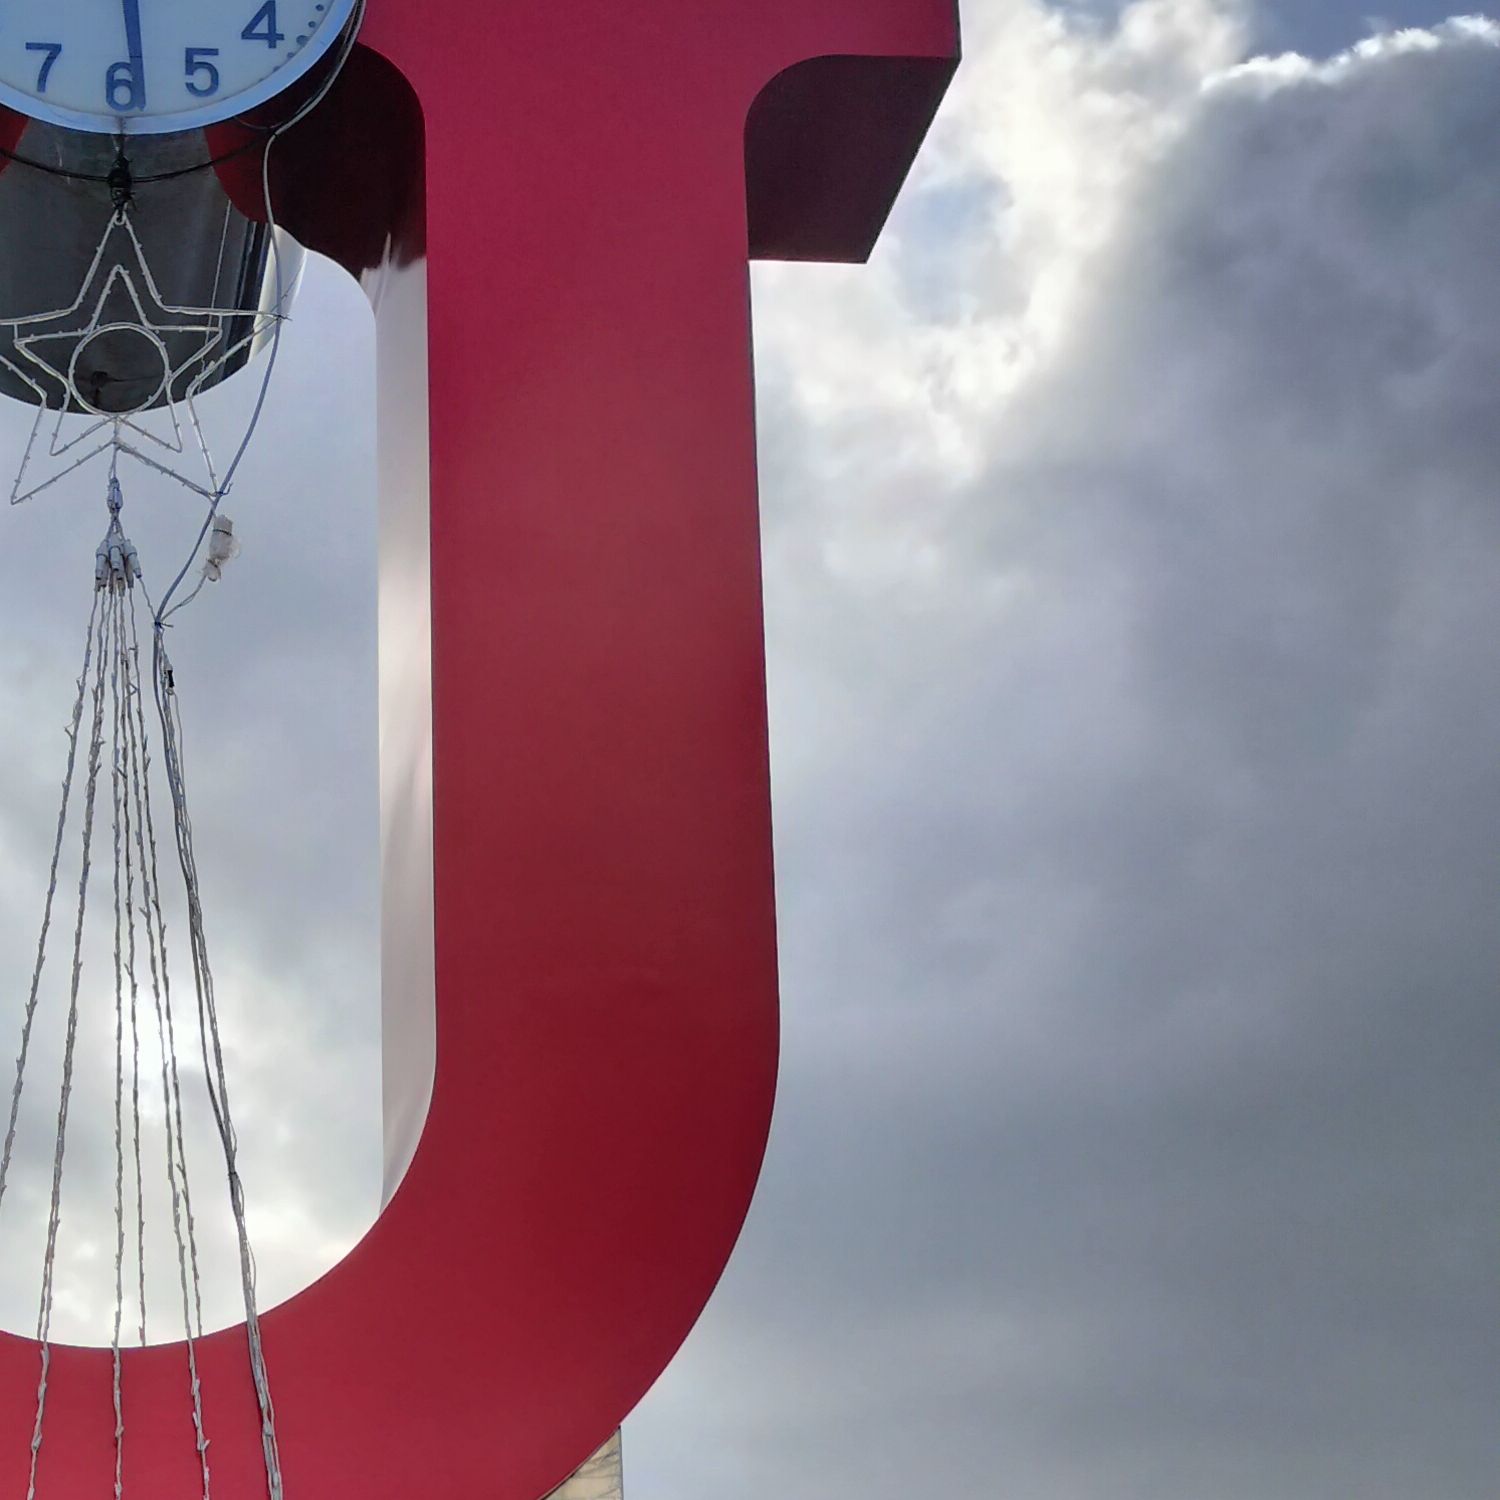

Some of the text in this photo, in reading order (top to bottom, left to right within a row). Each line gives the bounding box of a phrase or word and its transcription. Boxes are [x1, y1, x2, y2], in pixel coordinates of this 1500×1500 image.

[241, 0, 284, 48] 4
[25, 42, 62, 92] 7
[105, 61, 138, 111] 6
[184, 48, 220, 97] 5
